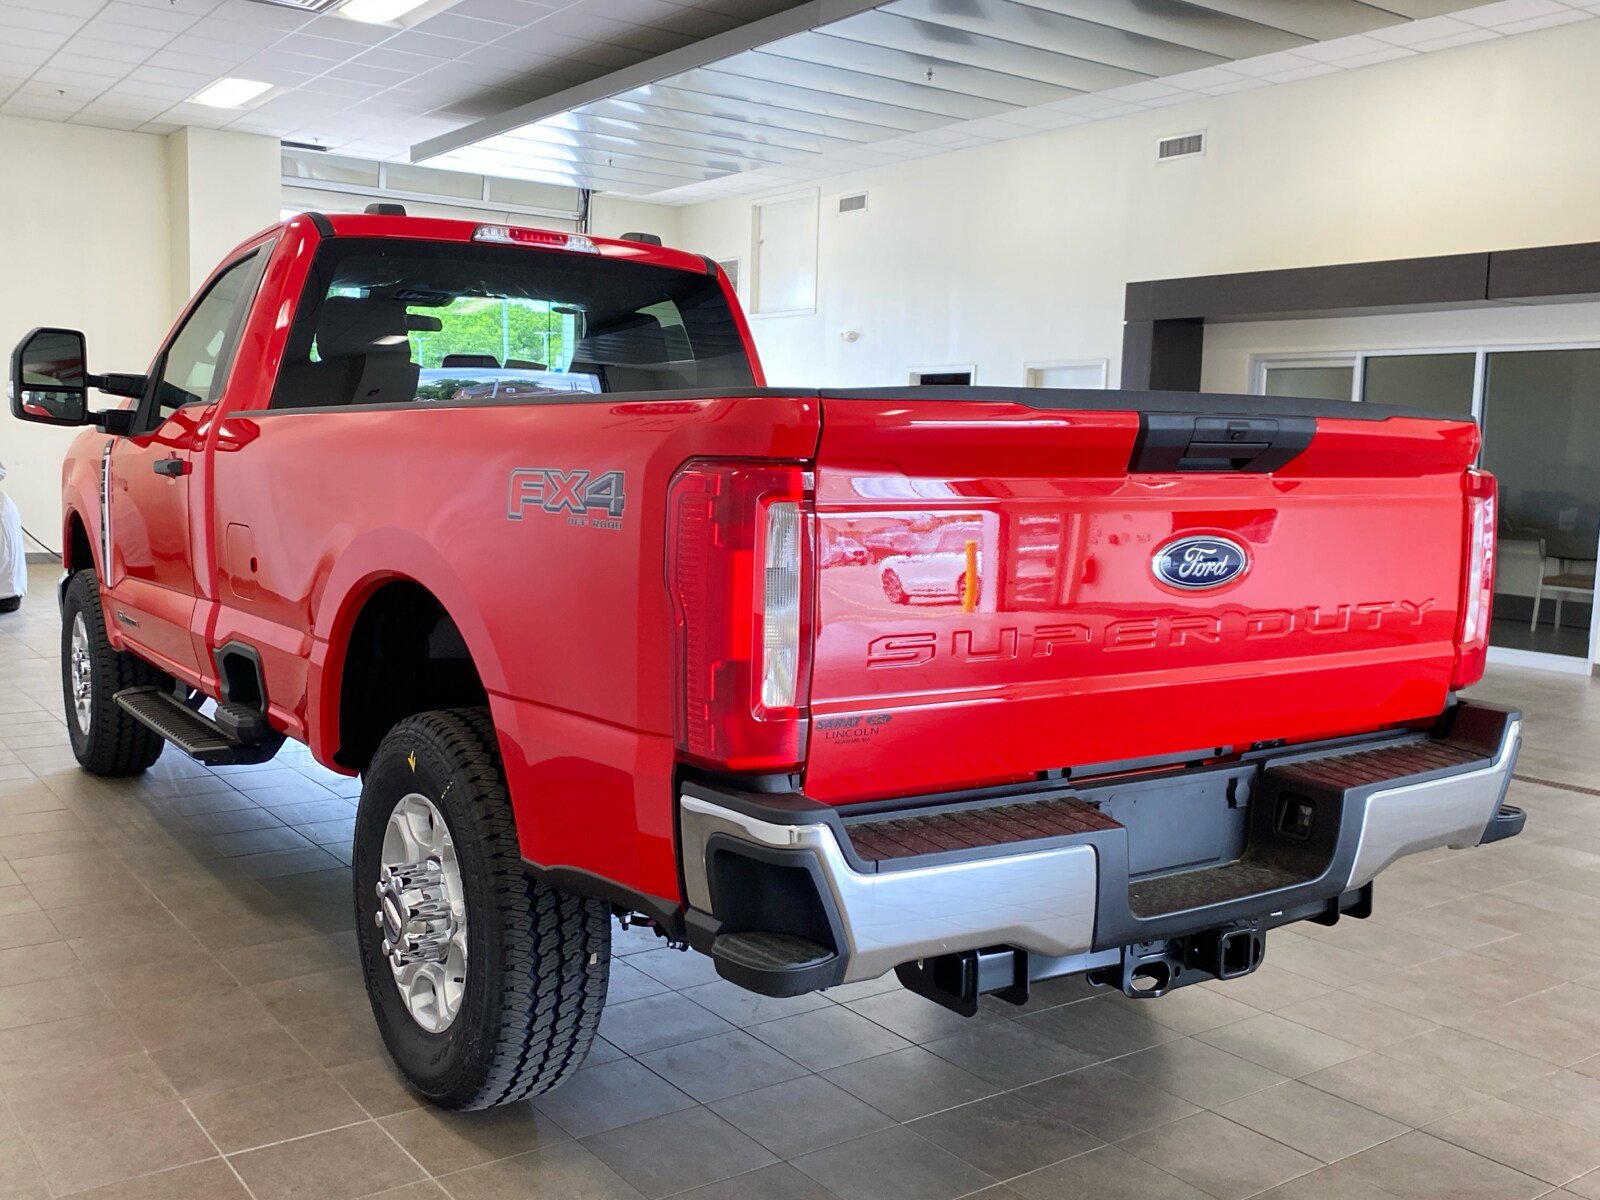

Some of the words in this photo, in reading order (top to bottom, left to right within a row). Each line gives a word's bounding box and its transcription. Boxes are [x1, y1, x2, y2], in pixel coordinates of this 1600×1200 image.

[507, 467, 626, 522] FX4
[567, 517, 589, 526] OFF
[592, 519, 623, 530] ROAD
[1178, 544, 1229, 578] Ford
[867, 614, 1221, 670] SUPER
[1246, 598, 1436, 641] DUTY
[816, 716, 861, 730] SARAT
[826, 728, 879, 740] LINCOLN
